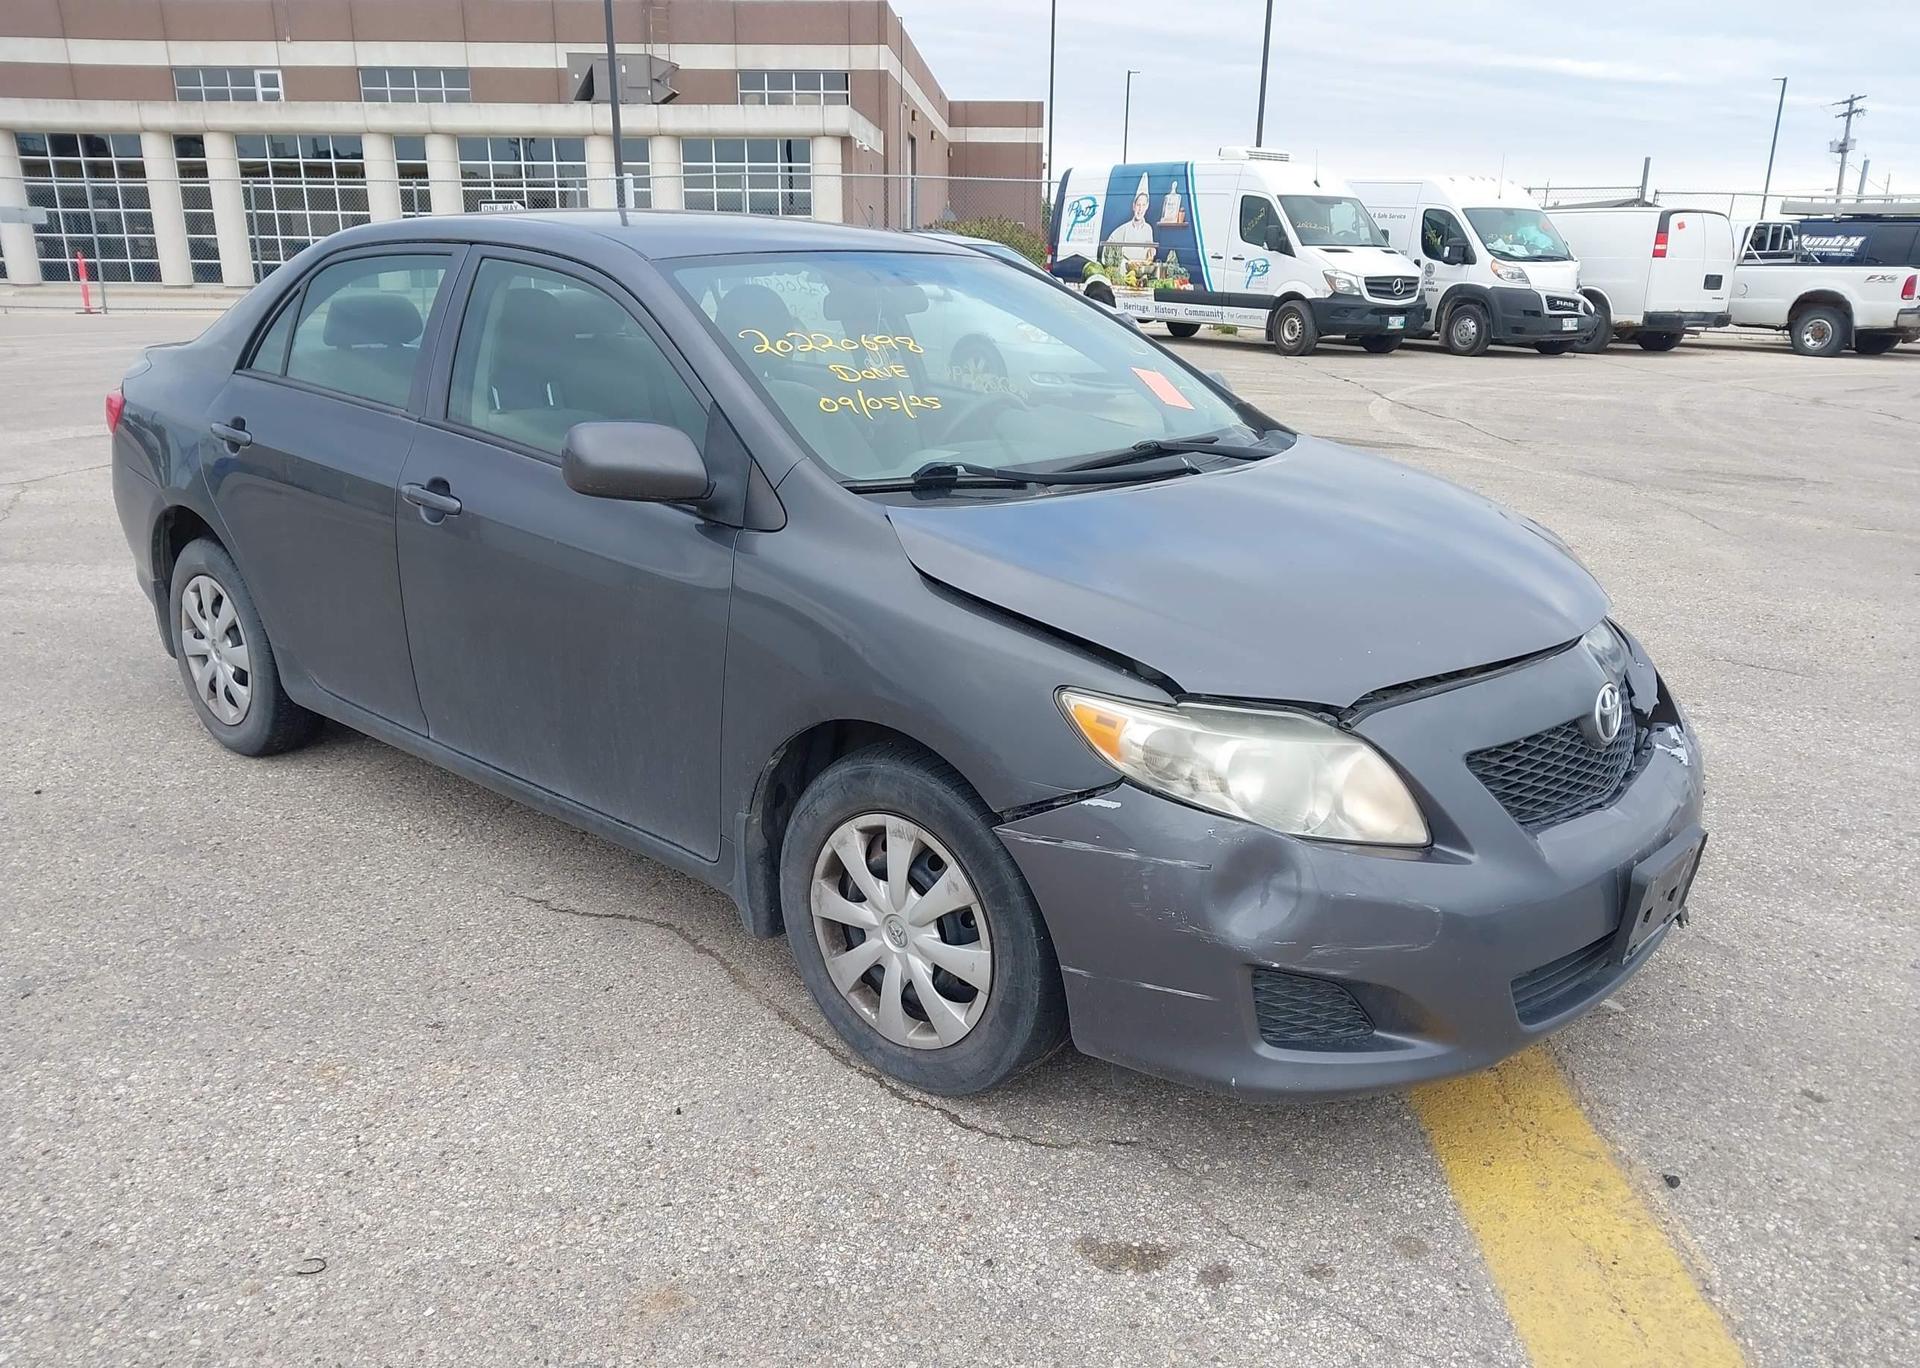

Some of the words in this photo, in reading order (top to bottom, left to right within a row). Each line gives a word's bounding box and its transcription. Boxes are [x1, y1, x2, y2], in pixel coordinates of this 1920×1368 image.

[1123, 302, 1151, 314] Heritage.
[1154, 305, 1180, 316] History.
[1184, 308, 1226, 320] Community.
[1556, 300, 1575, 308] RAM
[819, 389, 942, 420] 09/05/25
